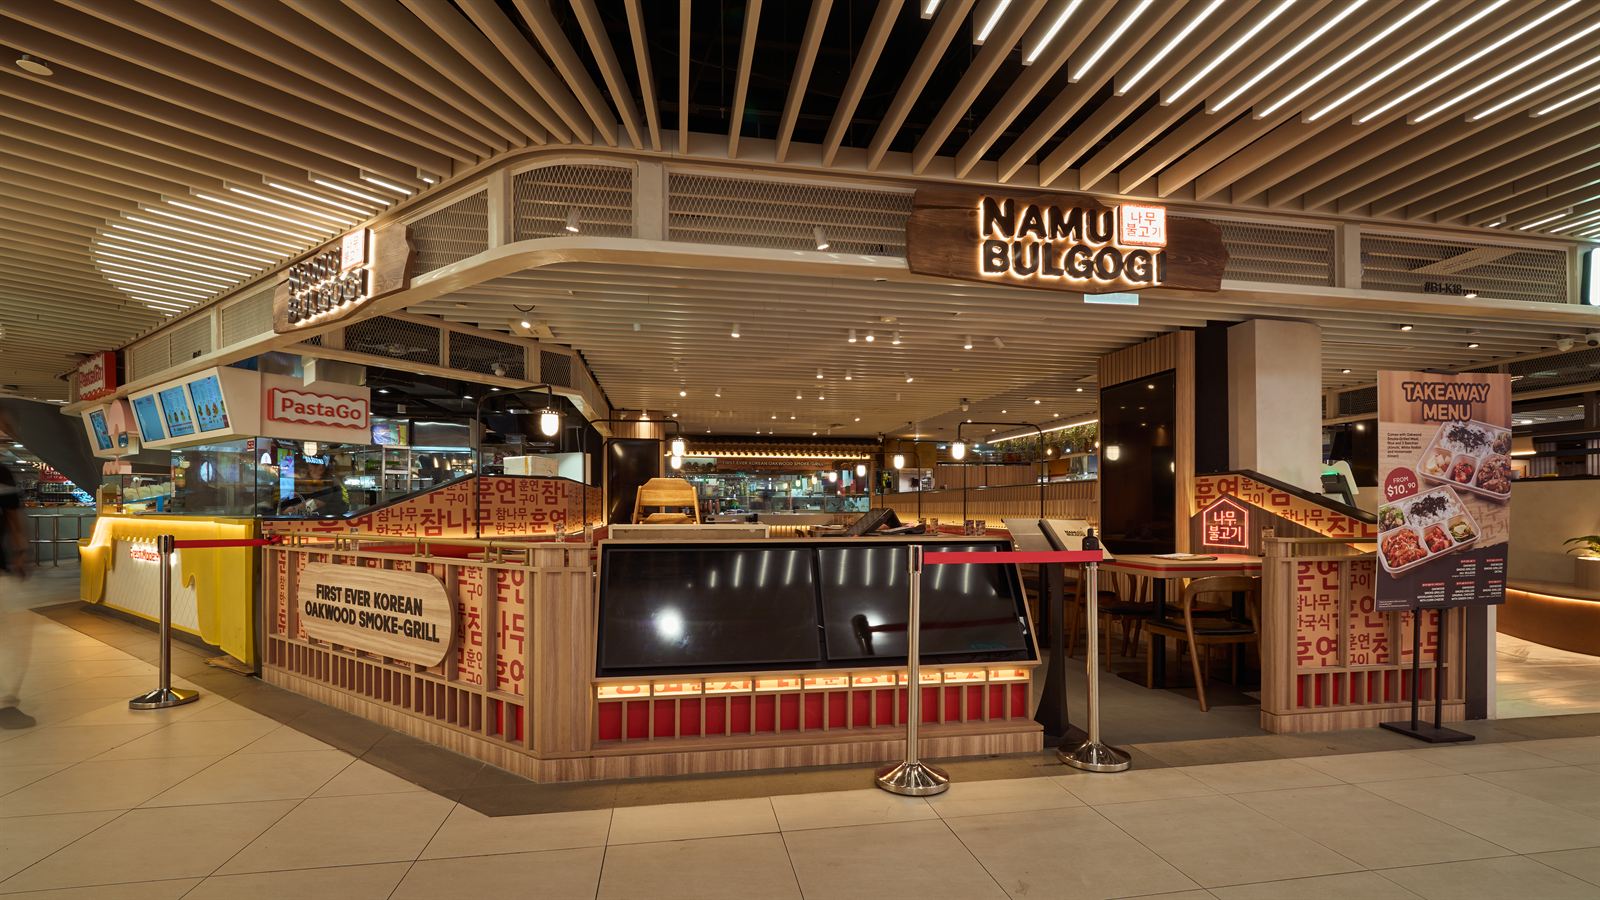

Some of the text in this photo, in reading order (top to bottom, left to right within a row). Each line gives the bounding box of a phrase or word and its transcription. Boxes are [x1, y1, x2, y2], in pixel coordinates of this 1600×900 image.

[981, 195, 1115, 244] NAMU
[1131, 211, 1156, 226] 나무
[1126, 223, 1161, 238] 불고기
[289, 246, 342, 295] NAMU
[981, 239, 1167, 285] BULGOGI
[288, 267, 369, 323] BULGOGI
[1424, 281, 1462, 295] #B1-K18
[1402, 382, 1490, 402] TAKEAWAY
[281, 397, 362, 420] PastaGo
[1422, 402, 1472, 421] MENU
[519, 479, 539, 492] 훈연
[1387, 482, 1416, 497] $10.90
[445, 493, 469, 506] 구이
[519, 493, 538, 506] 구이
[421, 508, 495, 537] 참나무
[495, 507, 527, 521] 참나무
[1213, 511, 1237, 526] 나무
[495, 522, 527, 535] 한국식
[1208, 525, 1242, 542] 불고기
[316, 584, 422, 616] FIRST EVER KOREAN
[305, 601, 356, 625] OAKWOOD
[359, 610, 440, 643] SMOKE-GRILL
